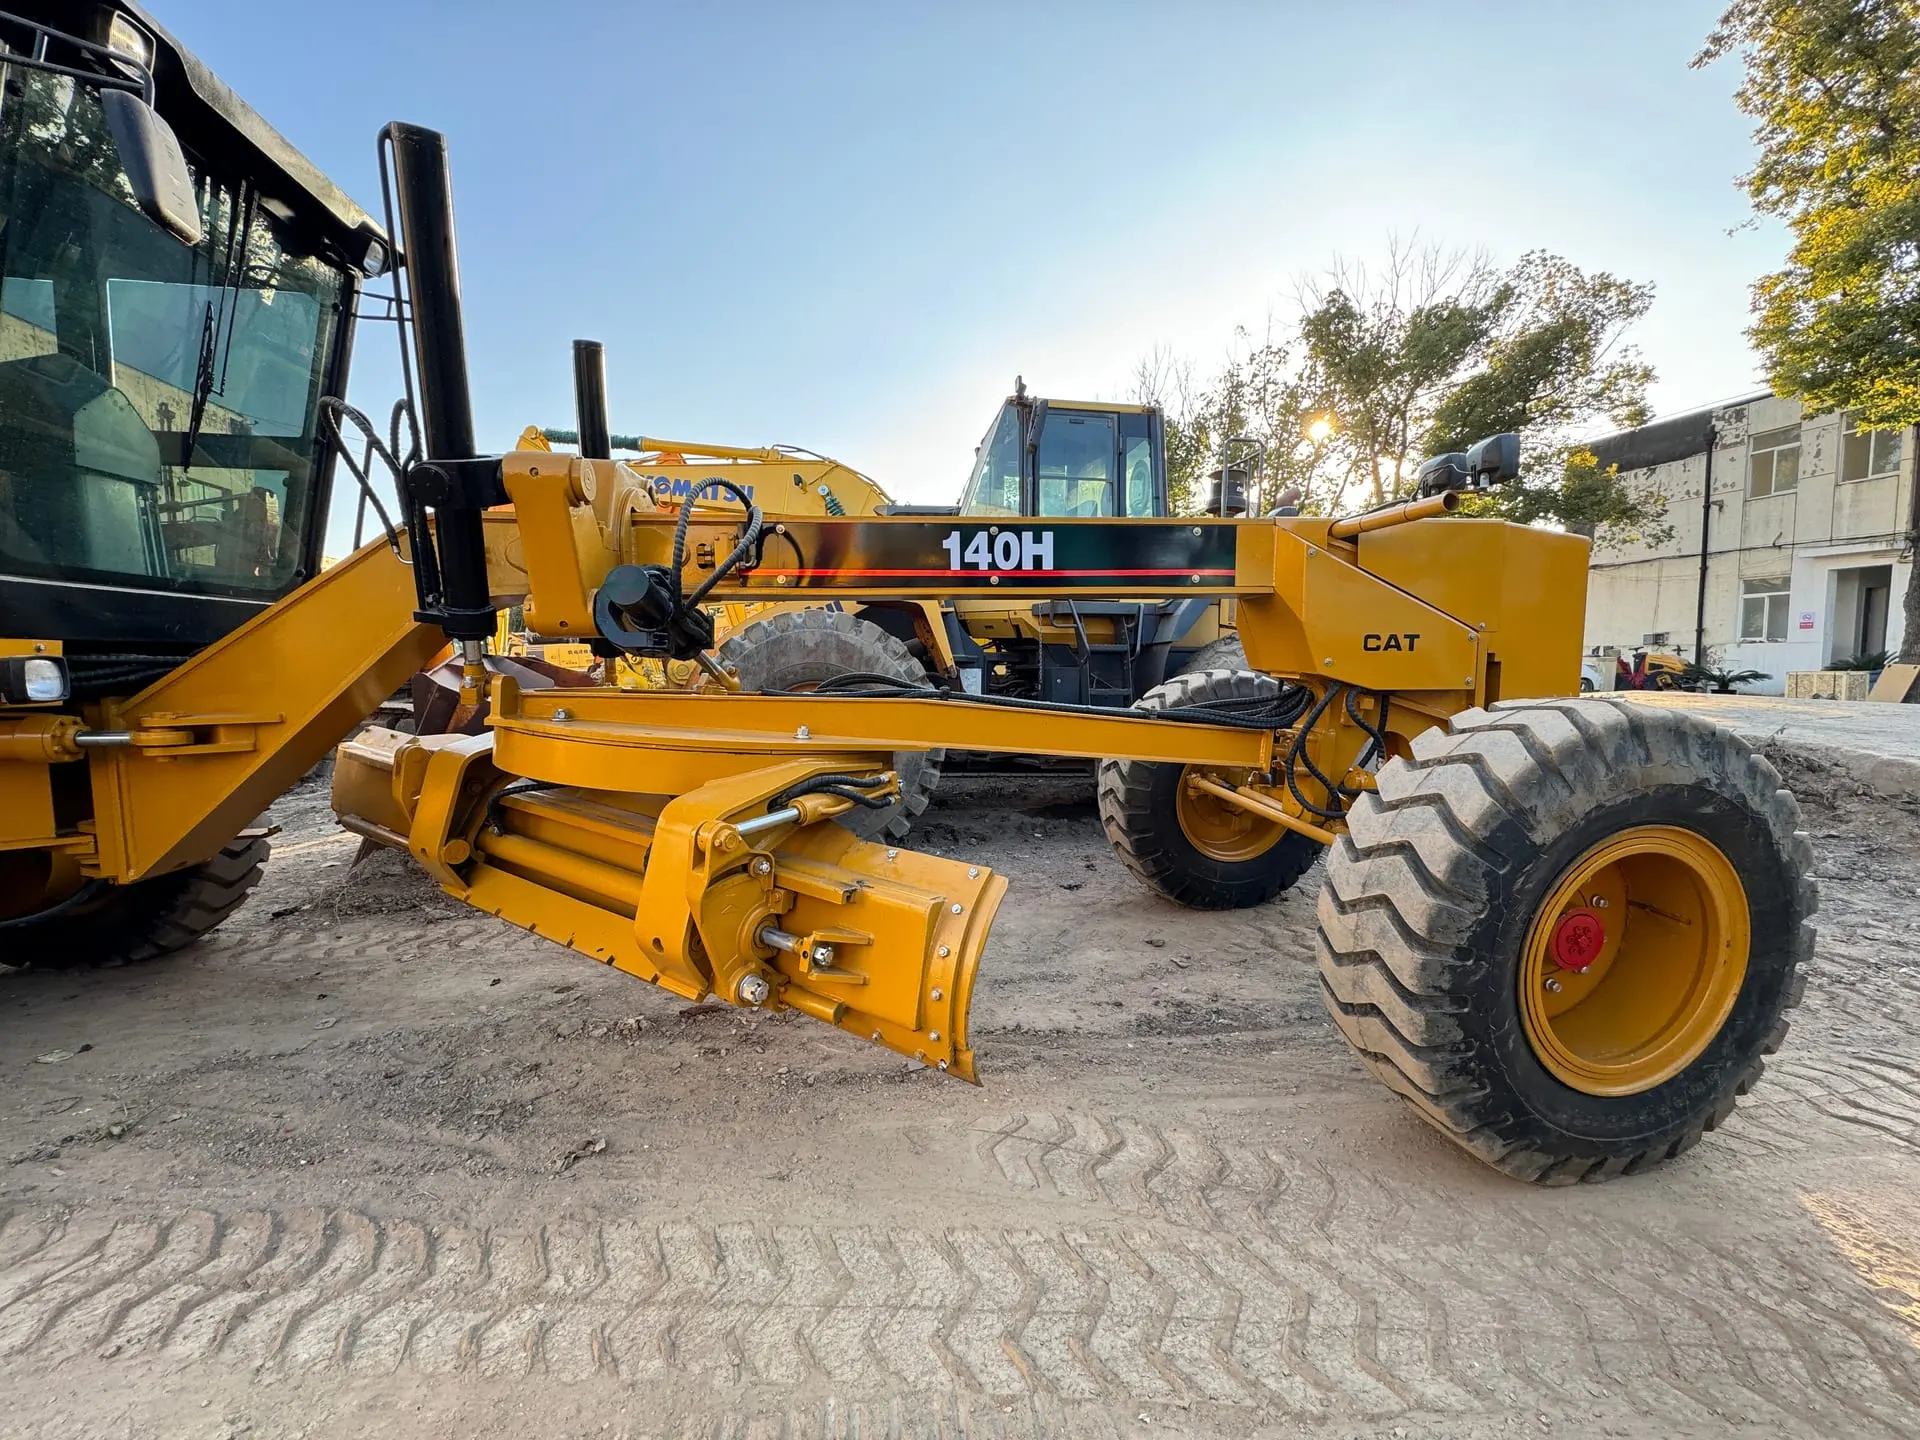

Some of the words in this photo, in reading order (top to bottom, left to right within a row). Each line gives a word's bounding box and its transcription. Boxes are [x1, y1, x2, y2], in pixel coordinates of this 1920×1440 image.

[646, 475, 754, 502] OMTSU
[942, 531, 1054, 570] 140H
[1363, 634, 1420, 651] CAT
